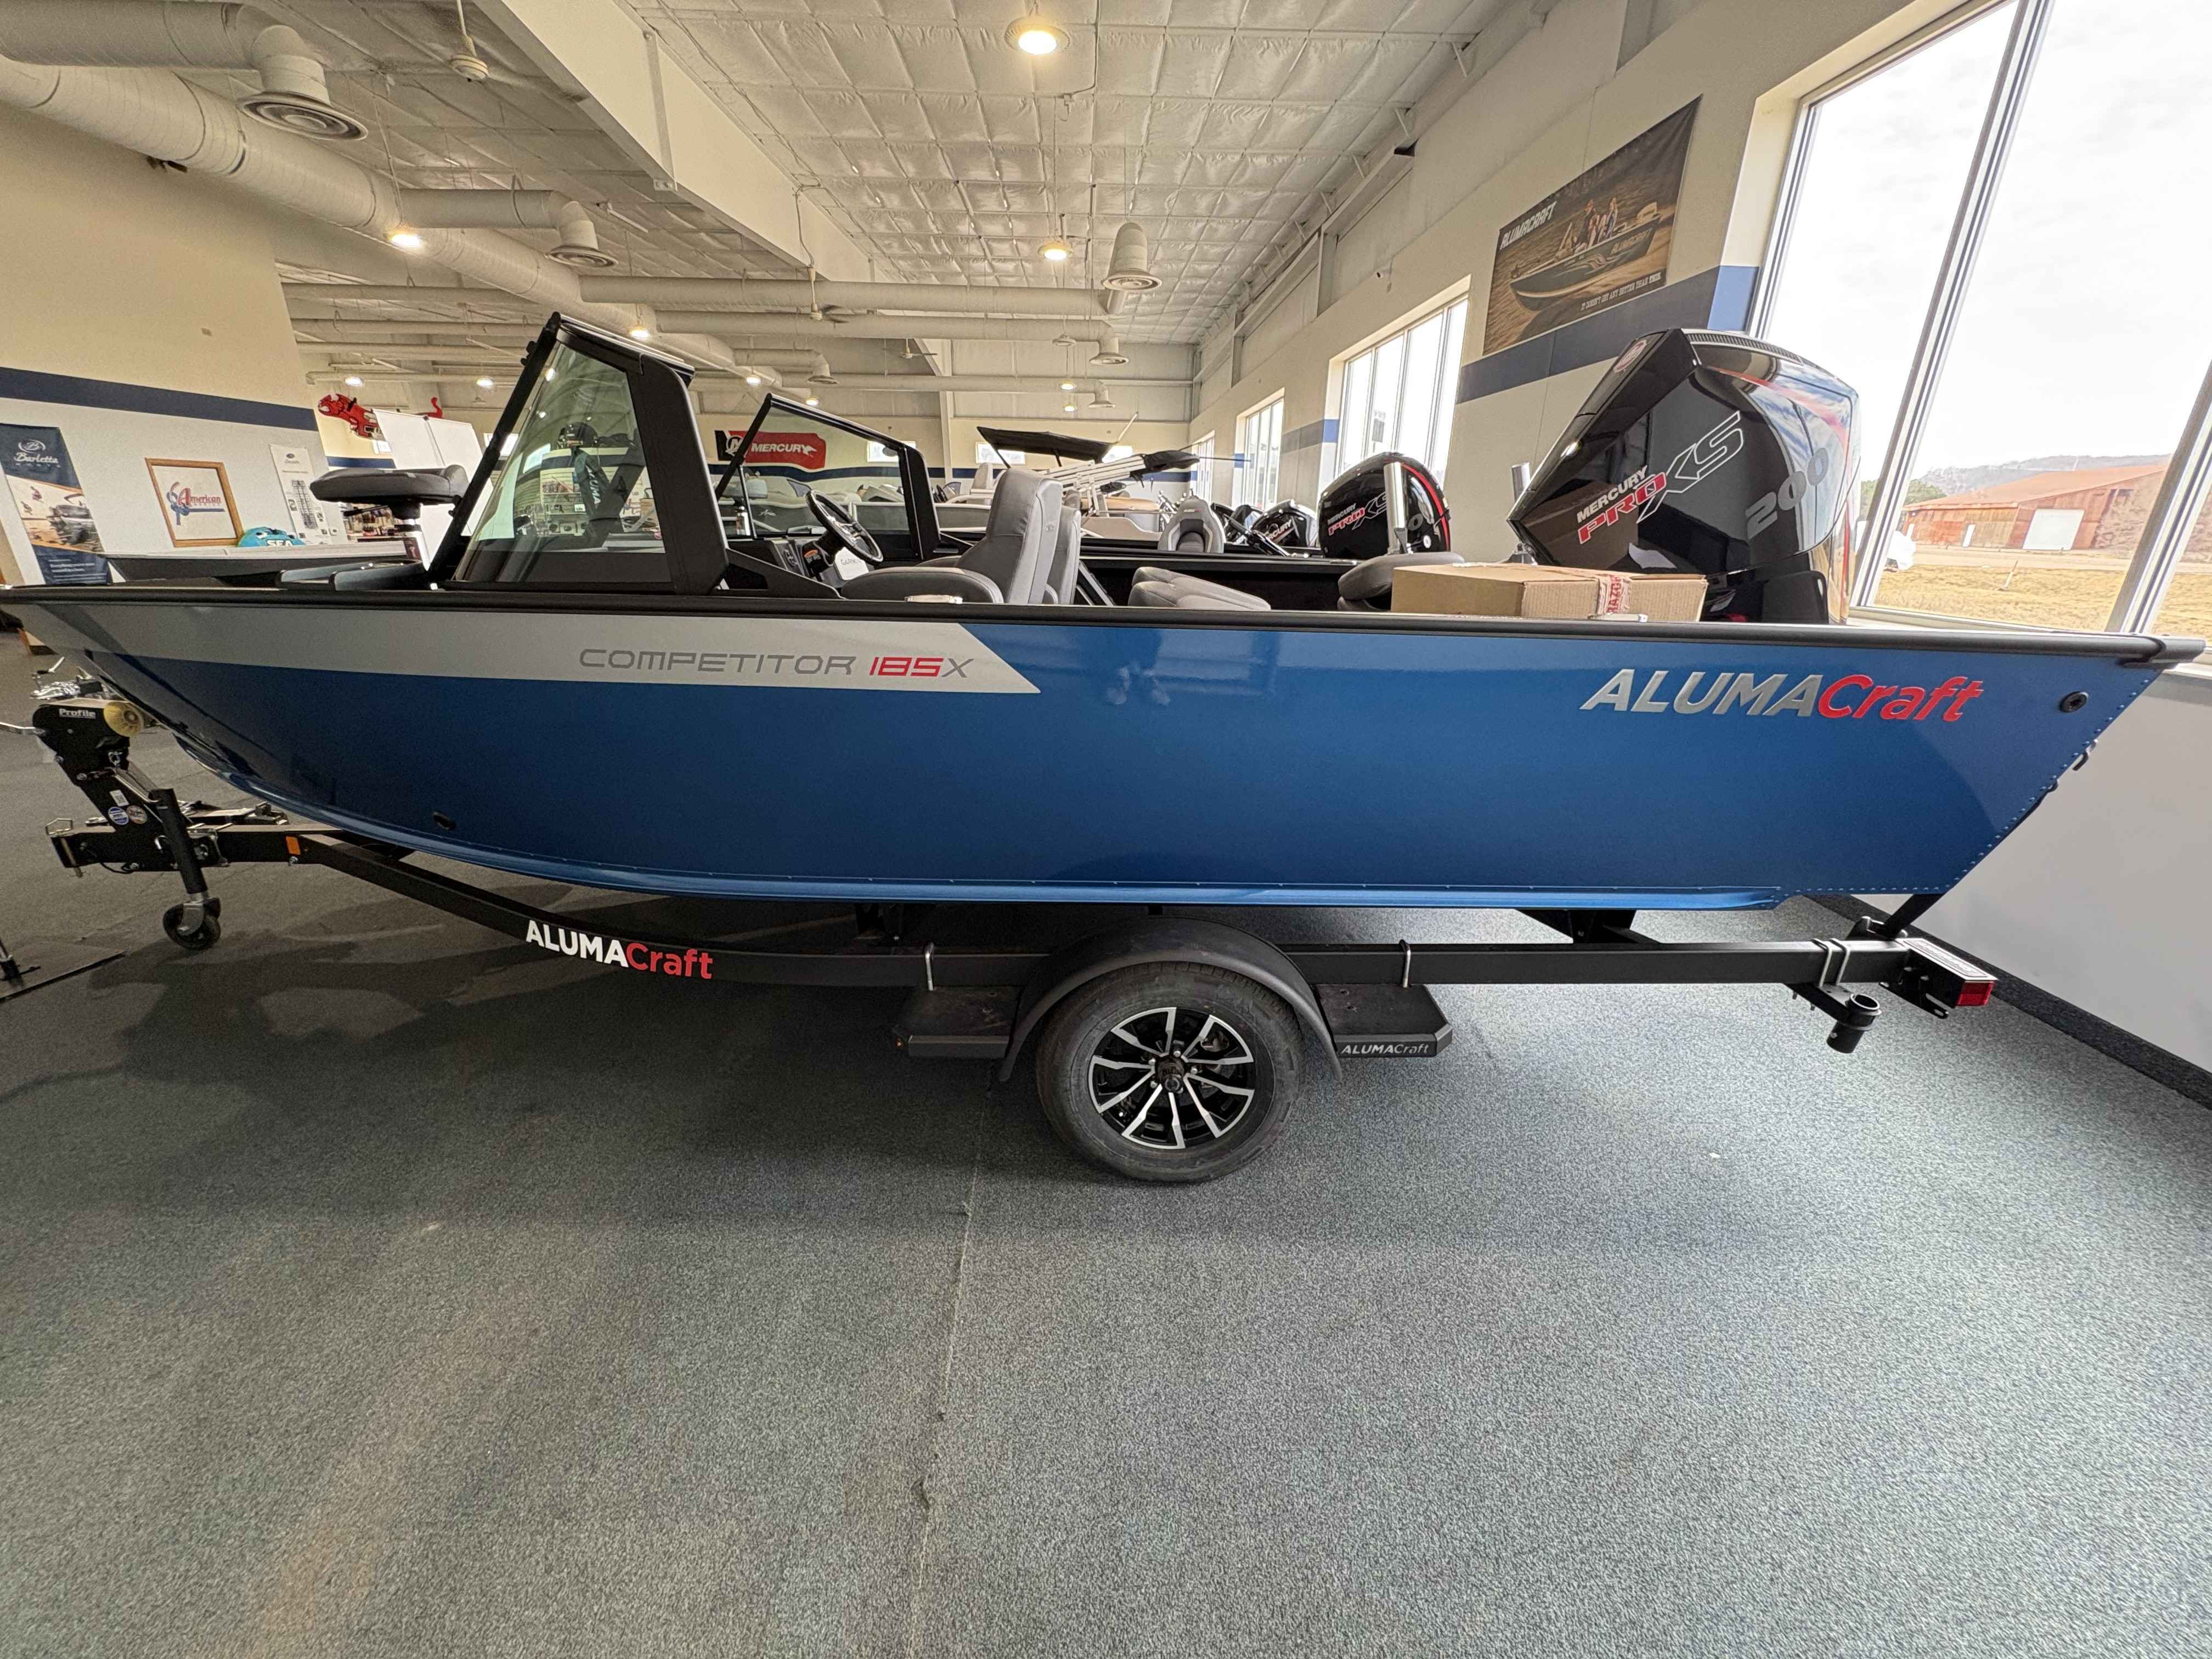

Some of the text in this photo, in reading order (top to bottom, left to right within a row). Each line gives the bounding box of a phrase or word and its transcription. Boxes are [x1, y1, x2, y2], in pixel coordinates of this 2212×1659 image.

[13, 452, 59, 464] Barletta
[751, 443, 808, 453] MERCURY
[1577, 410, 1744, 544] PRO XS
[178, 488, 221, 507] American
[1577, 466, 1648, 523] MERCURY
[1745, 447, 1829, 540] 200
[1328, 503, 1356, 524] MERCURY
[579, 649, 974, 678] COMPETITOR 185X
[1579, 669, 1984, 722] ALUMACraft
[59, 708, 96, 718] Profile
[526, 919, 713, 979] ALUMACraft
[1341, 1043, 1429, 1054] ALUMACraft
